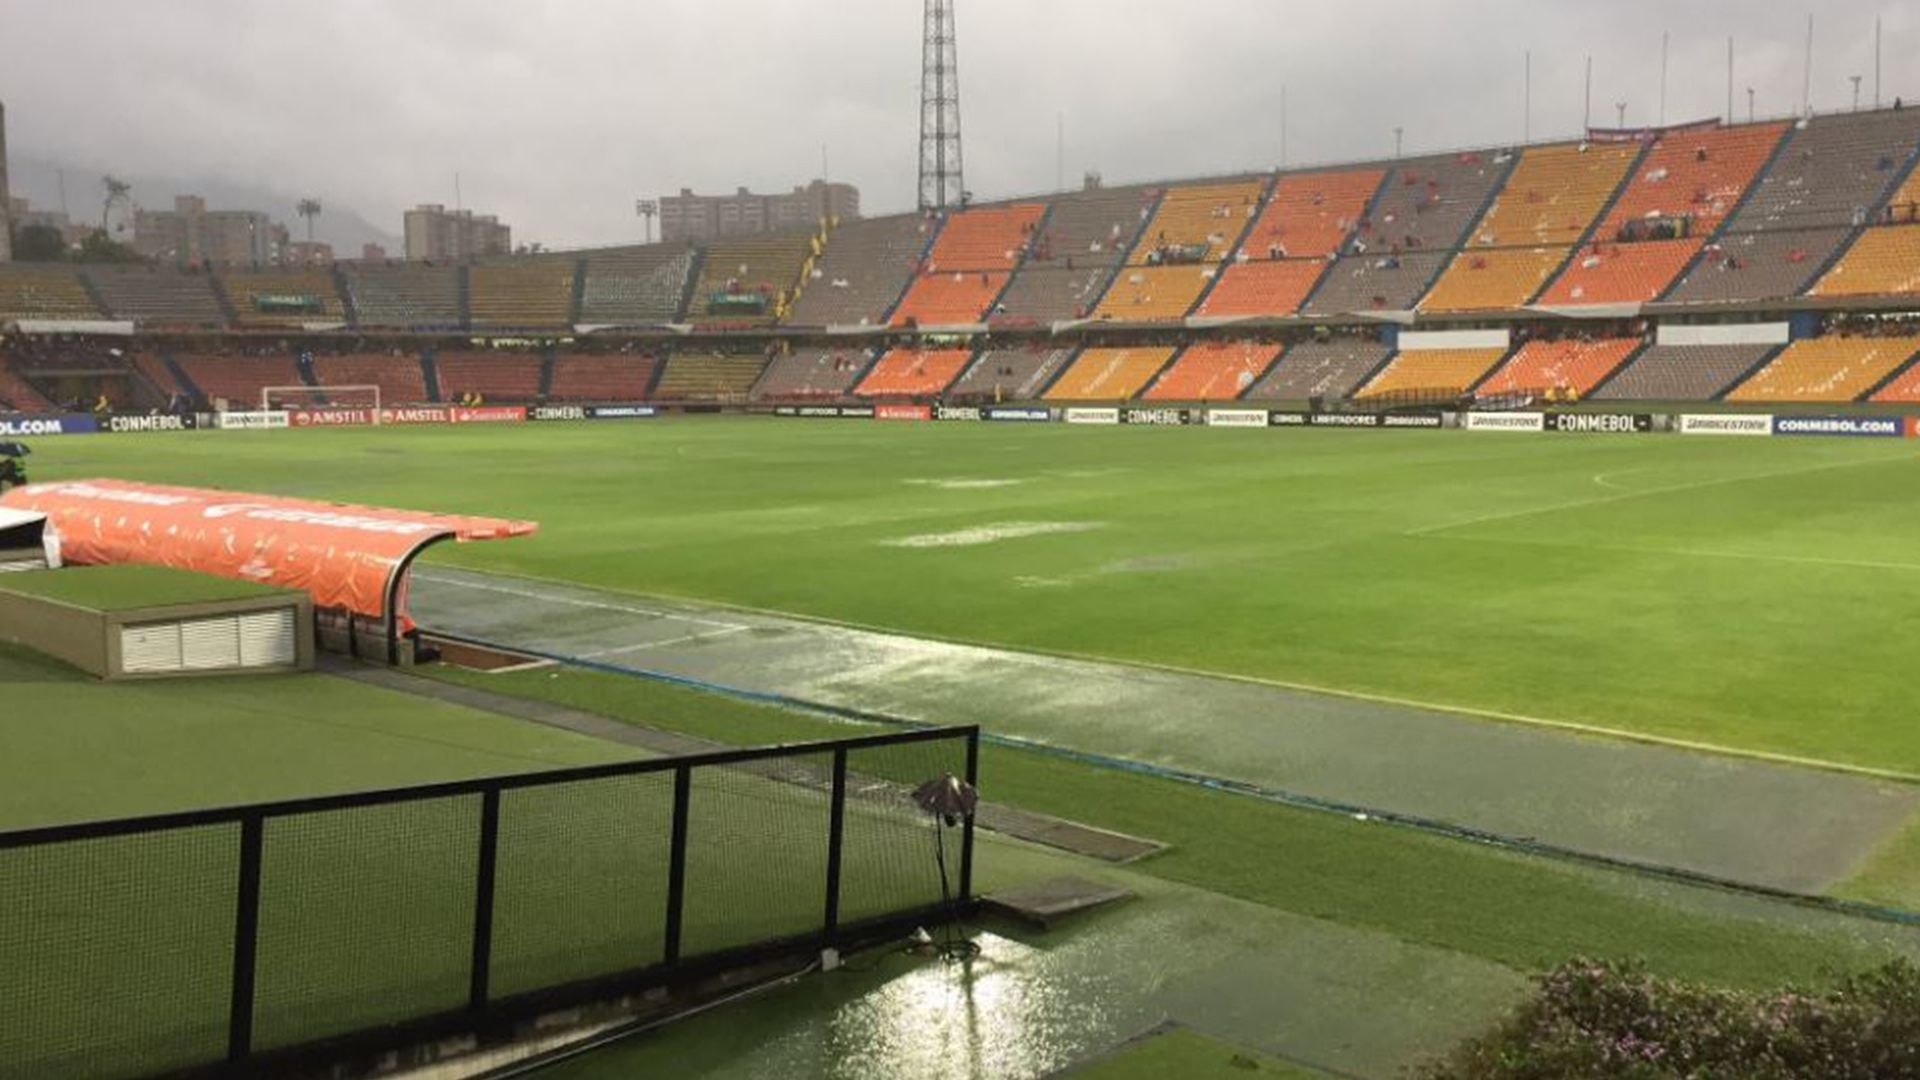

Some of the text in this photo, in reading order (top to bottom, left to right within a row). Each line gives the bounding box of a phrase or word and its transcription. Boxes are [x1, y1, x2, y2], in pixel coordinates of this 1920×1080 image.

[396, 409, 446, 421] AMSTEL
[111, 415, 184, 431] CONMEBOL
[1557, 414, 1638, 431] CONMEBOL
[1778, 419, 1896, 432] CONMEBOL.COM
